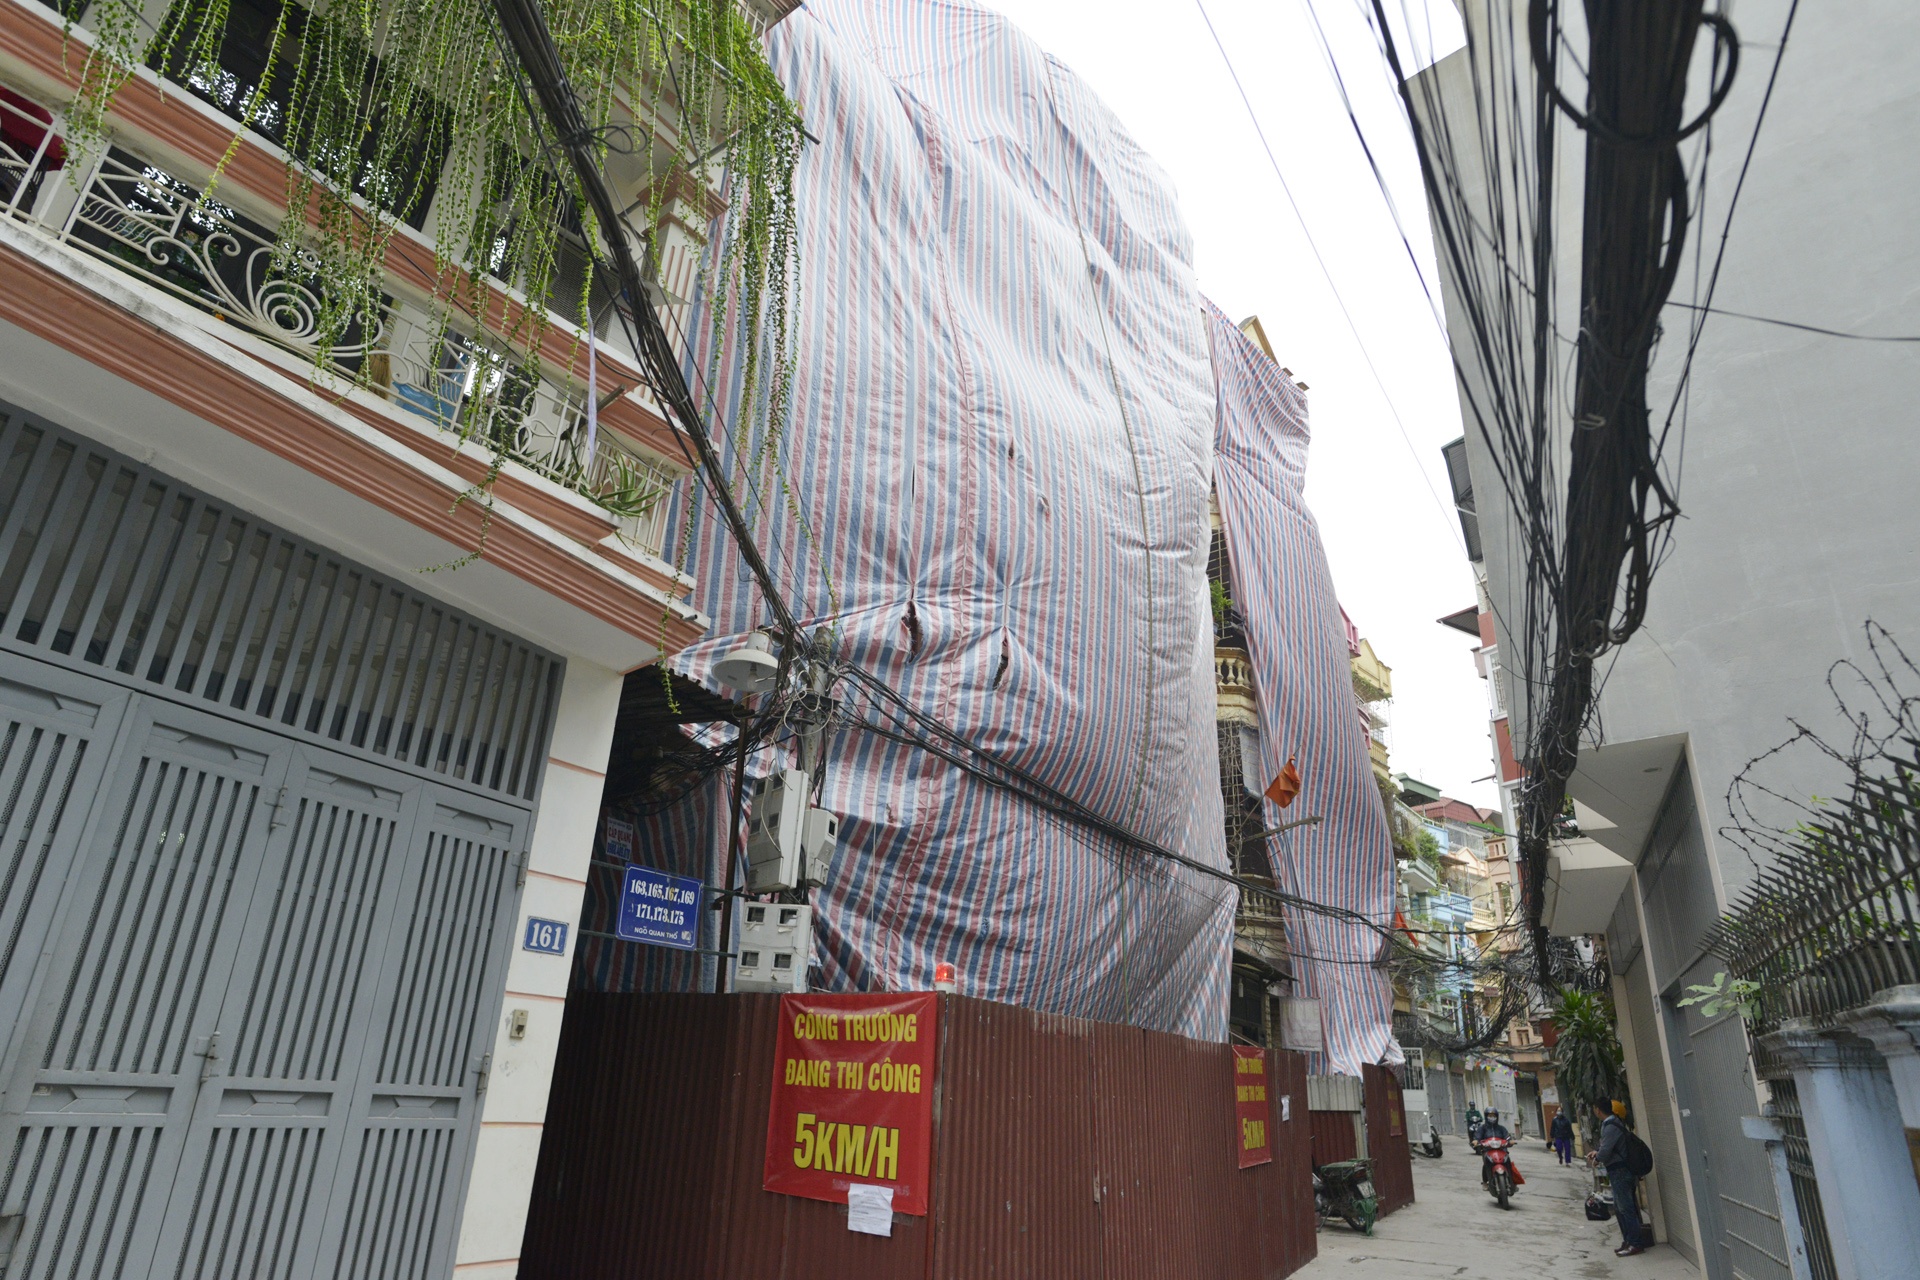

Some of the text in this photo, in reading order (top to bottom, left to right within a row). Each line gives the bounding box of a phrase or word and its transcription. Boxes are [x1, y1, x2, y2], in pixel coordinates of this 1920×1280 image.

[630, 879, 695, 905] 163,165,167,169
[530, 922, 562, 950] 161
[634, 925, 647, 935] NGÕ
[649, 929, 665, 937] QUAN
[794, 1007, 917, 1042] CÔNG TRƯỜNG
[785, 1056, 921, 1093] ĐANG THI CÔNG
[792, 1112, 900, 1181] 5KM/H
